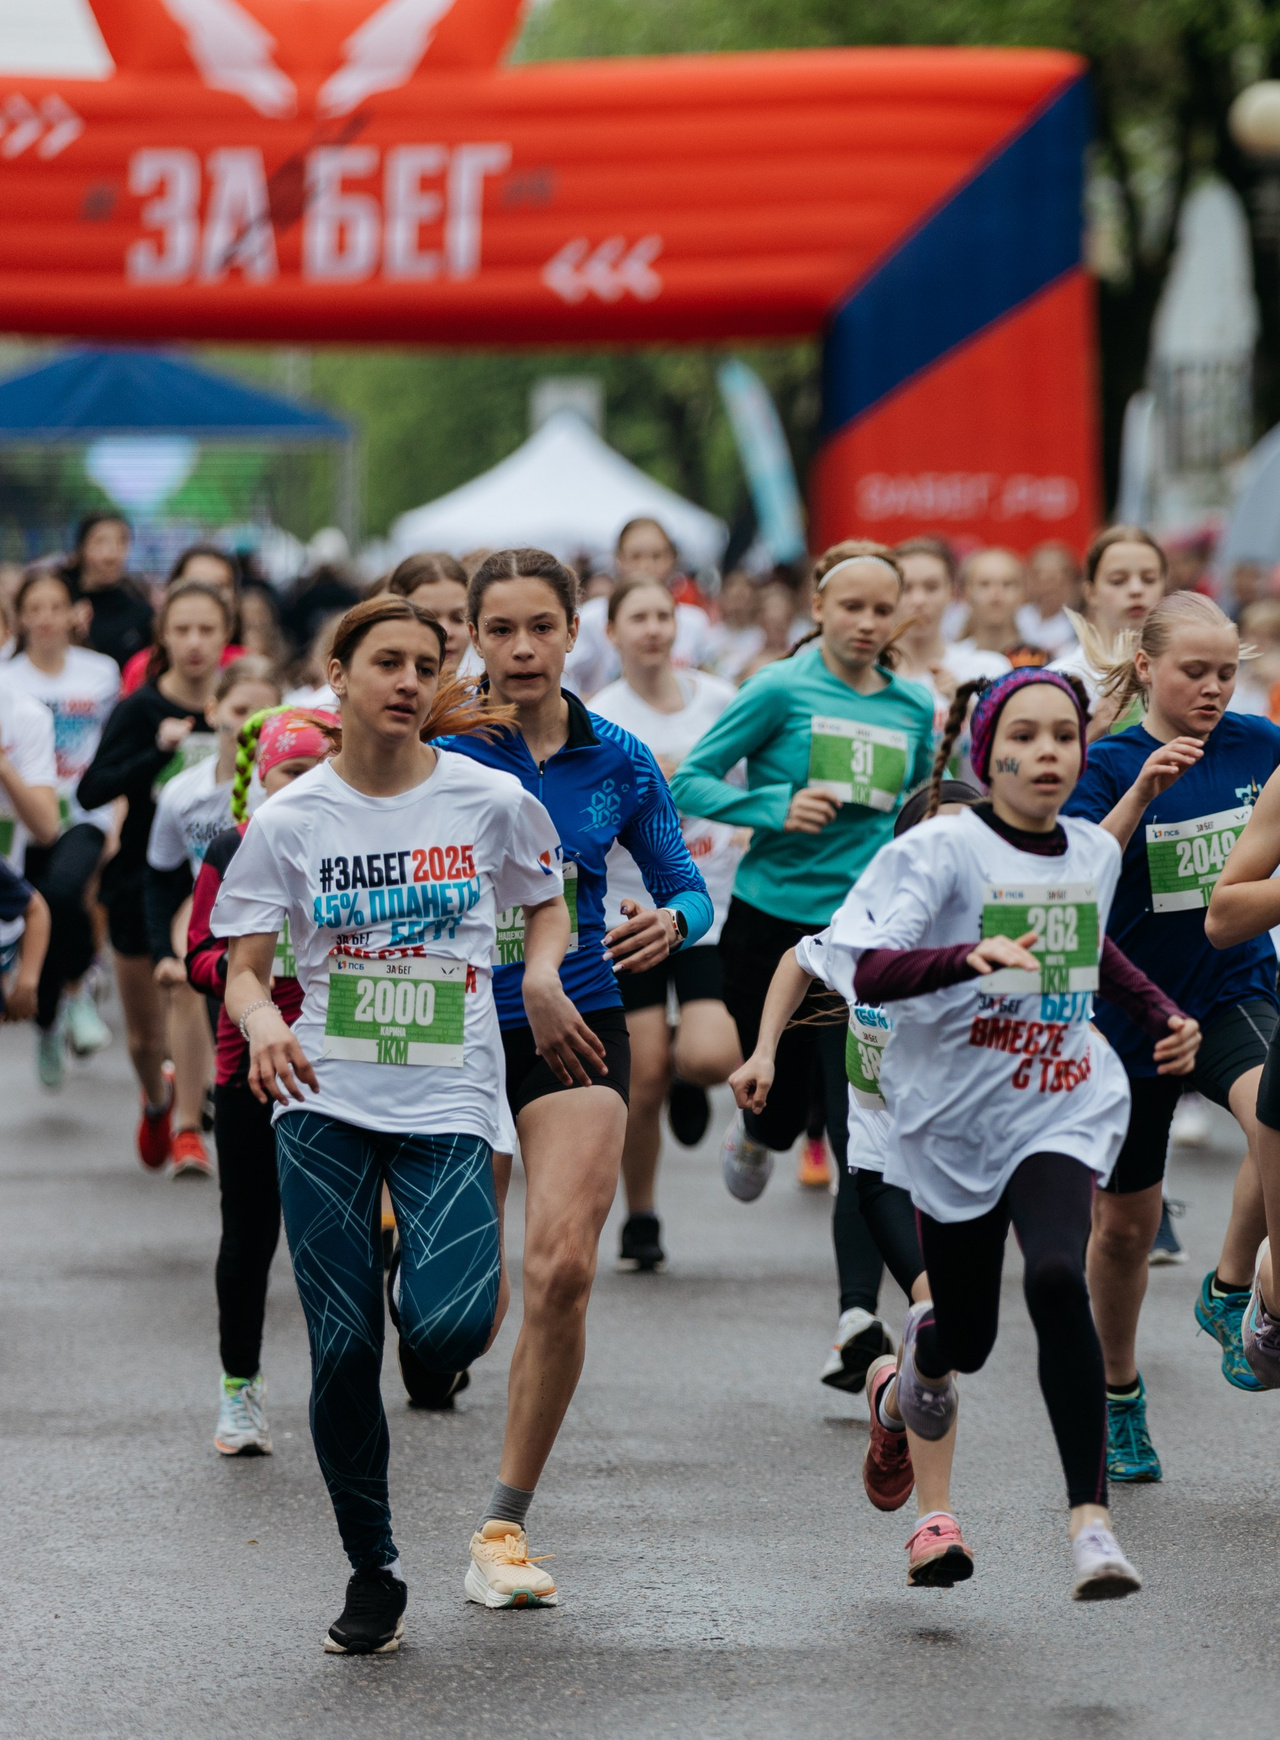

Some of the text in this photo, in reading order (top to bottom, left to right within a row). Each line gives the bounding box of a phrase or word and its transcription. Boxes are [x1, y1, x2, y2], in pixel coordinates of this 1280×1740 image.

[126, 142, 512, 287] ЗА БЕГ
[850, 739, 874, 776] 31
[320, 845, 476, 893] #ЗАБЕГ2025
[1176, 831, 1237, 877] 2049
[369, 876, 481, 923] ПЛАНЕТЫ
[1027, 905, 1078, 952] 262
[348, 962, 365, 971] ПСБ
[355, 978, 435, 1026] 2000
[380, 1026, 406, 1037] КАРИНА
[968, 1016, 1068, 1057] ВМЕСТЕ
[1012, 1057, 1033, 1090] С
